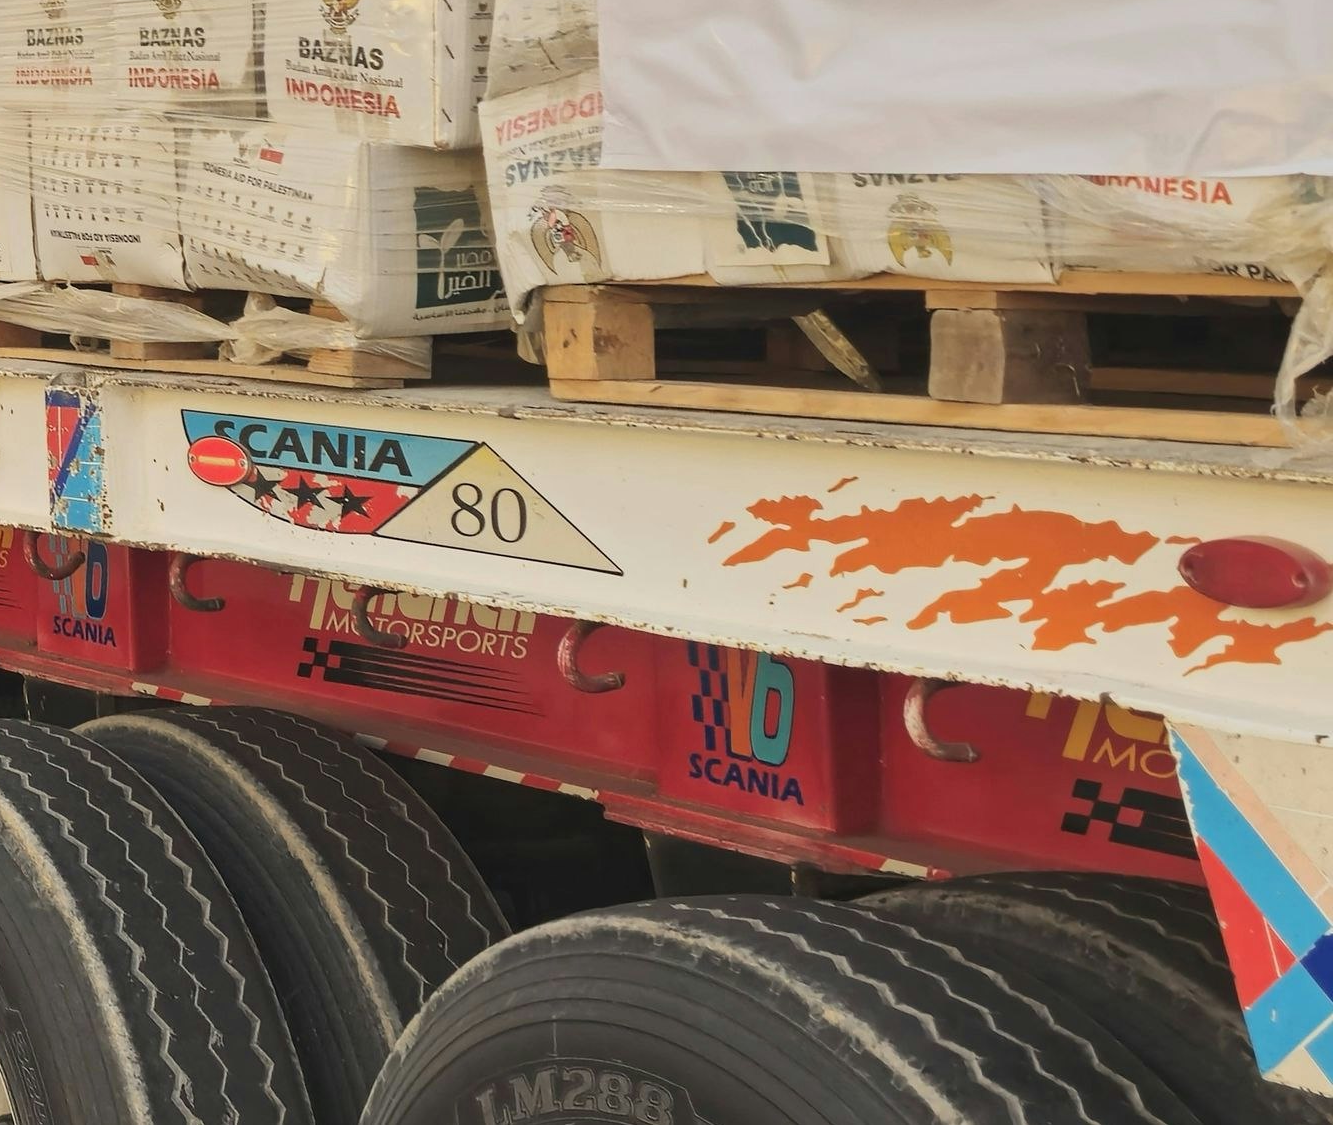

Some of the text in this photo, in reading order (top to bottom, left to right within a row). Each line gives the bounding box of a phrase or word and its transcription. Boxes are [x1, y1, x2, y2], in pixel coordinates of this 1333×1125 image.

[26, 27, 85, 47] BAZNAS
[138, 27, 206, 49] BAZNAS
[298, 35, 384, 71] BAZNAS
[15, 65, 94, 86] INDONESIA
[128, 66, 221, 91] INDONESIA
[284, 77, 402, 120] INDONESIA
[495, 91, 605, 146] DONESIA
[213, 419, 414, 478] SCANIA
[450, 482, 528, 544] 80
[52, 614, 119, 649] SCANIA
[688, 752, 805, 807] SCANIA
[475, 1065, 675, 1125] LM288
